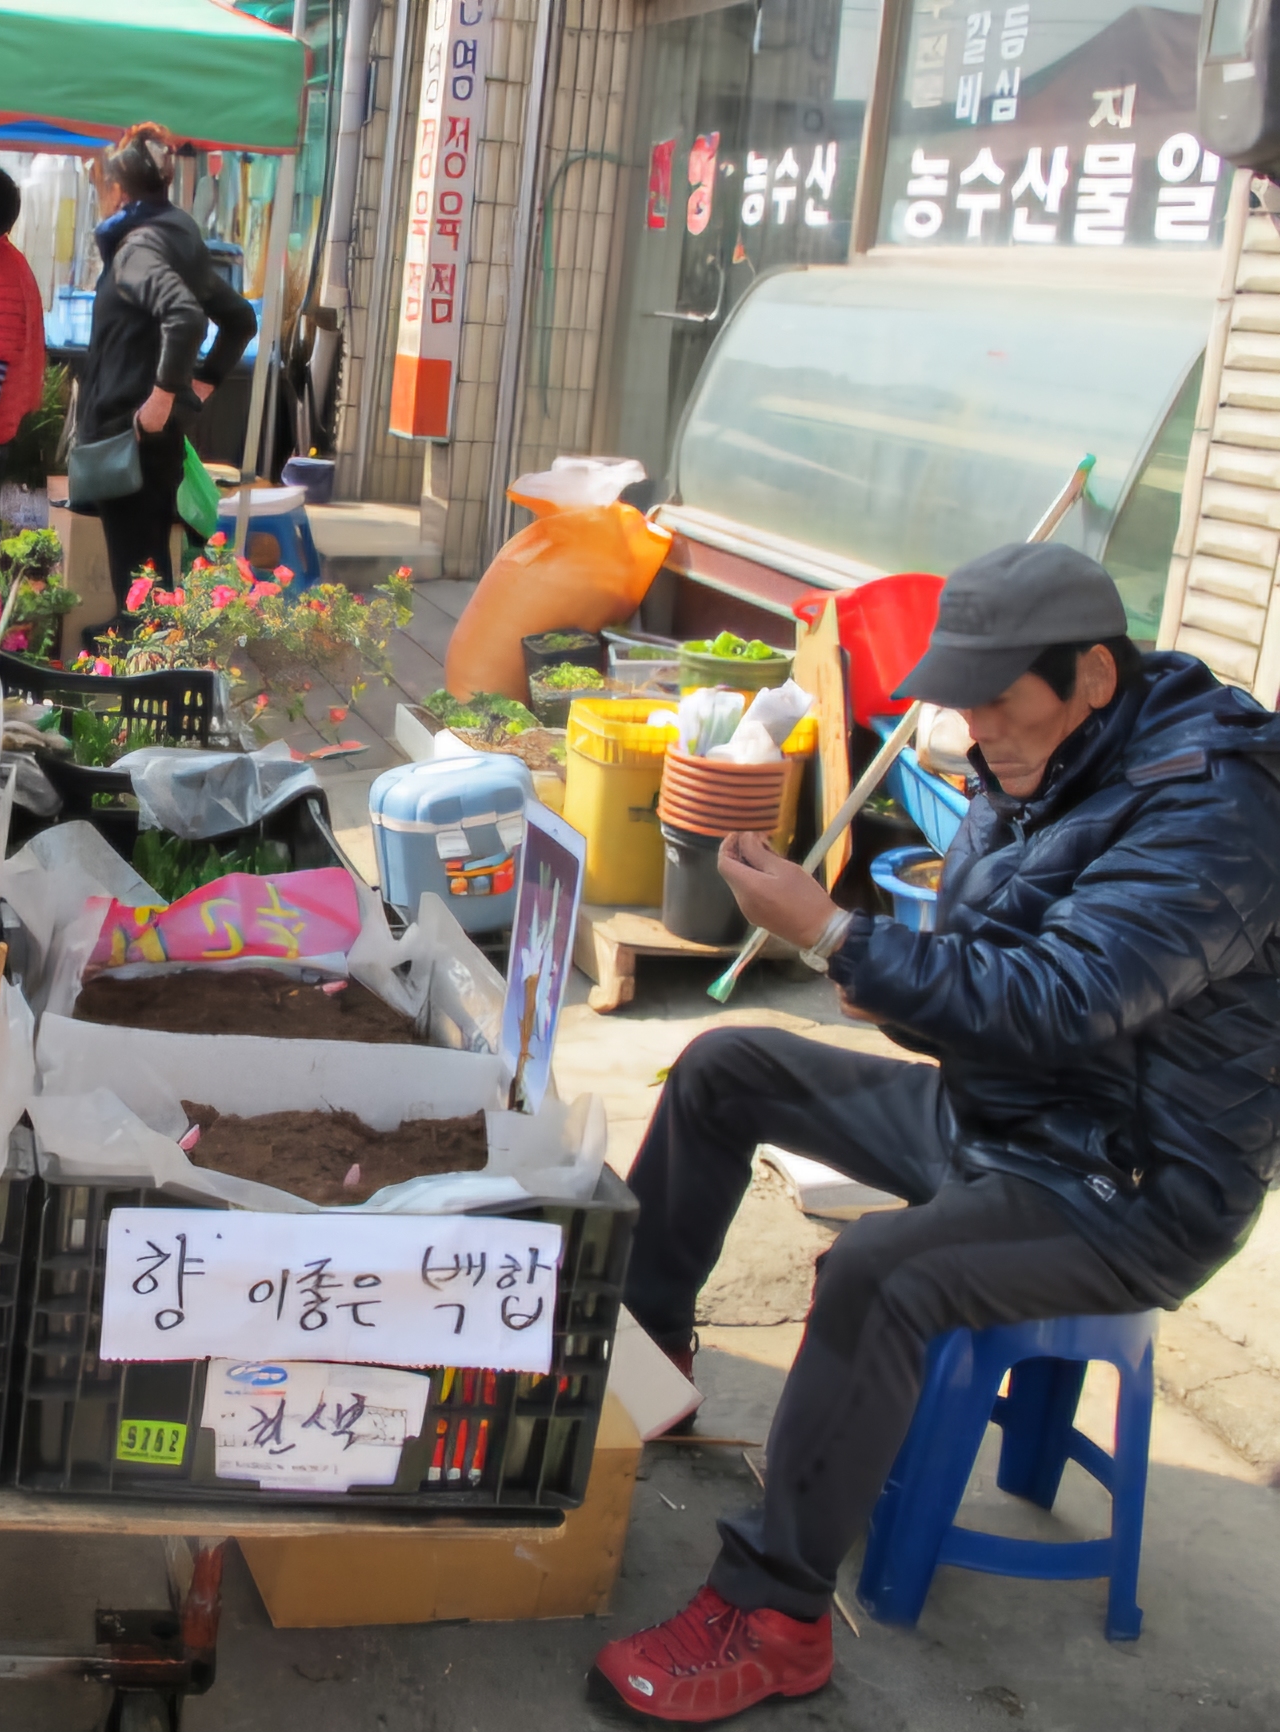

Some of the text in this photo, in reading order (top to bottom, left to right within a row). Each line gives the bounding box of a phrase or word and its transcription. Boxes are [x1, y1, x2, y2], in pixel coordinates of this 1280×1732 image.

[956, 10, 992, 124] 갈비
[990, 3, 1030, 122] 등심
[741, 141, 838, 227] 농수산
[132, 1233, 206, 1332] 향
[421, 1245, 553, 1335] 백합
